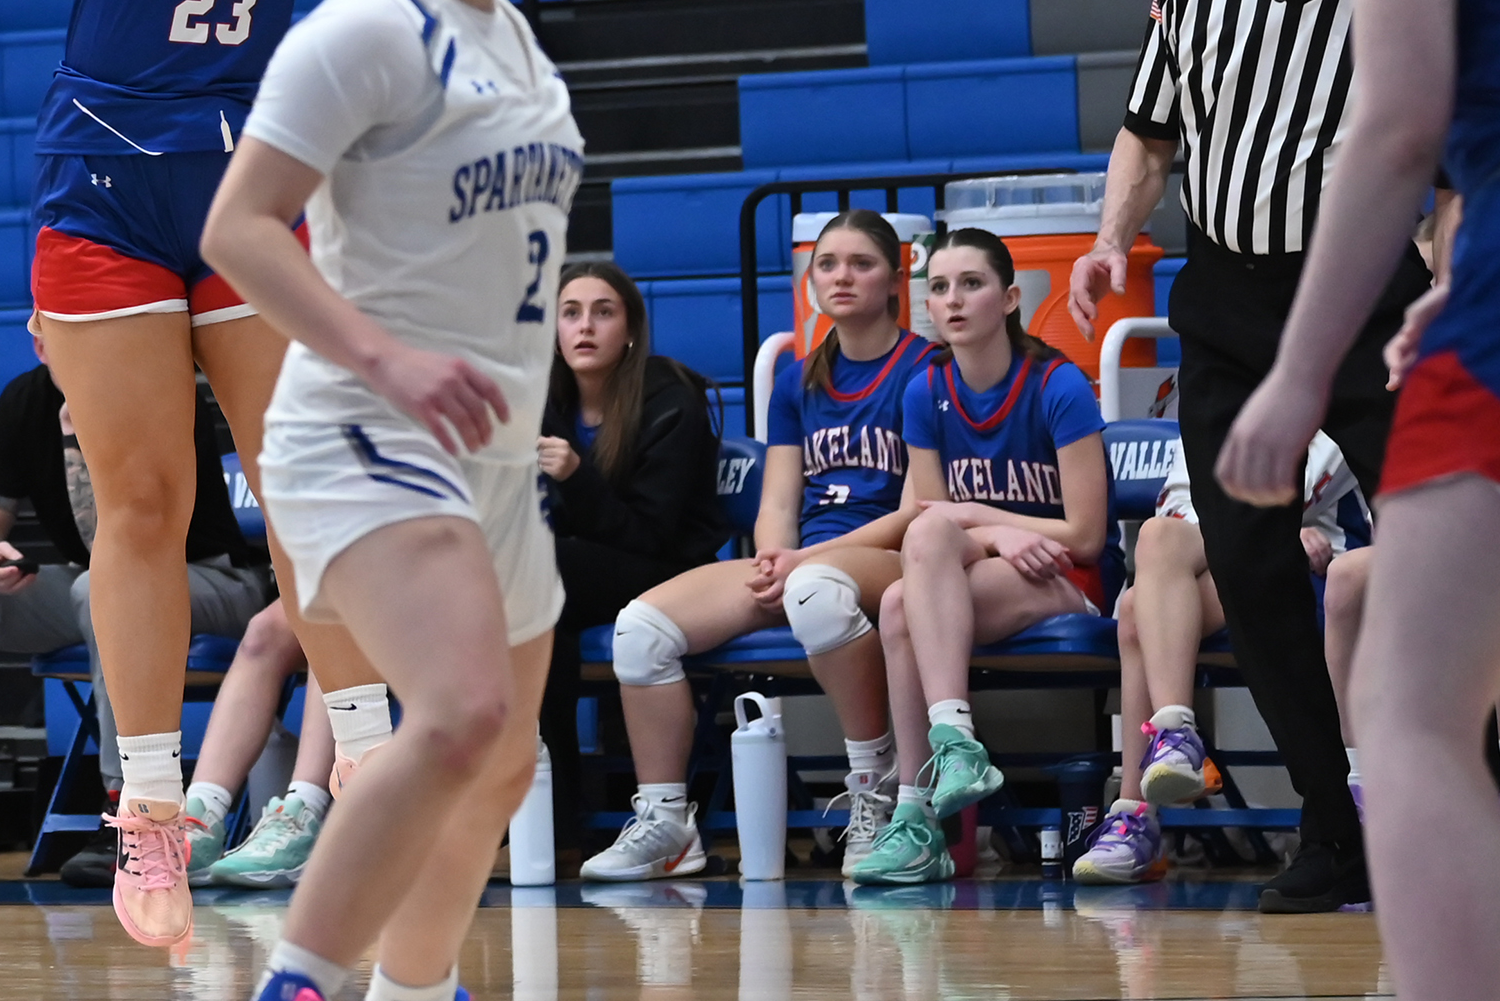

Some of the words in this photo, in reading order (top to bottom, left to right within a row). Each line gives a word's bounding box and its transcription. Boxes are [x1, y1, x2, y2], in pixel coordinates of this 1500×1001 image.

[515, 229, 551, 324] 2
[803, 424, 903, 476] AKELAND
[1110, 438, 1176, 481] VALLE
[948, 458, 1062, 505] AKELAND
